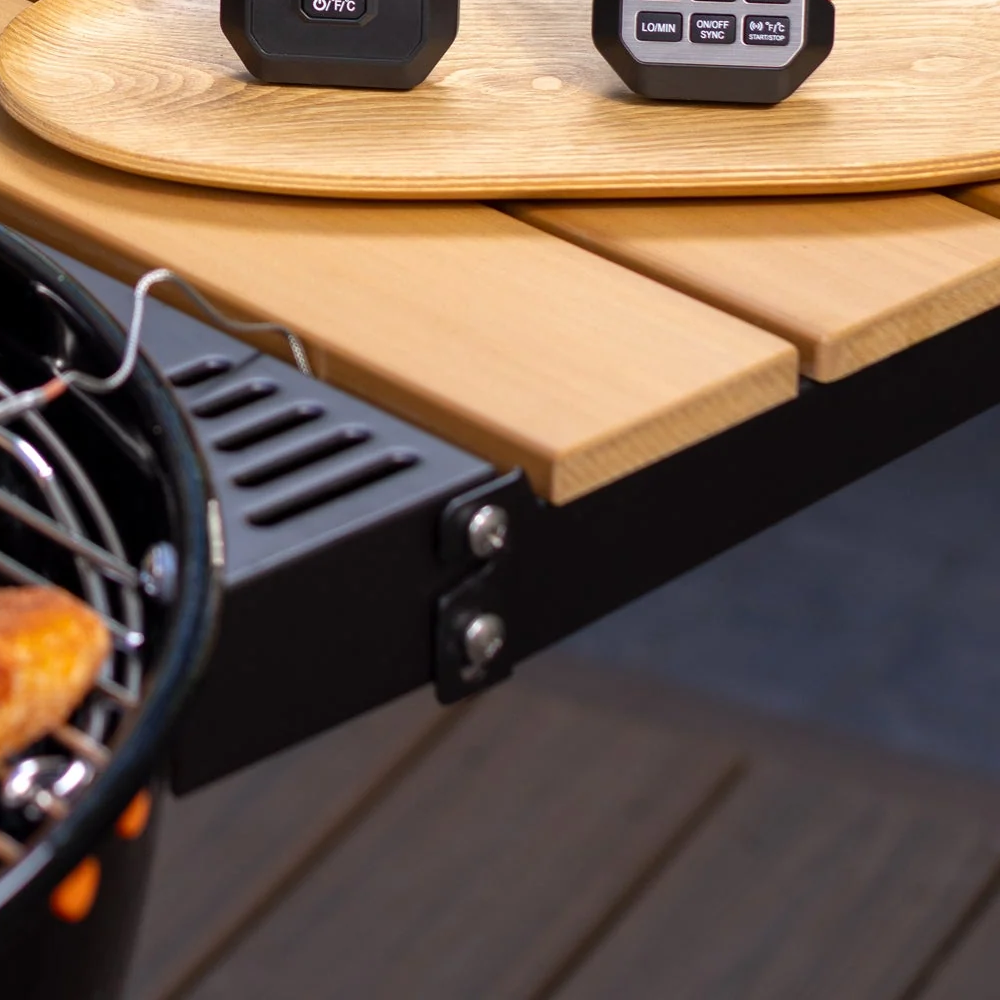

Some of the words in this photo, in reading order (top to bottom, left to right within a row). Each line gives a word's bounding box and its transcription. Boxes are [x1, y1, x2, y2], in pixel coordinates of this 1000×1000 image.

[641, 22, 676, 33] LO/MIN
[696, 20, 729, 30] ON/OFF
[700, 30, 725, 40] SYNC
